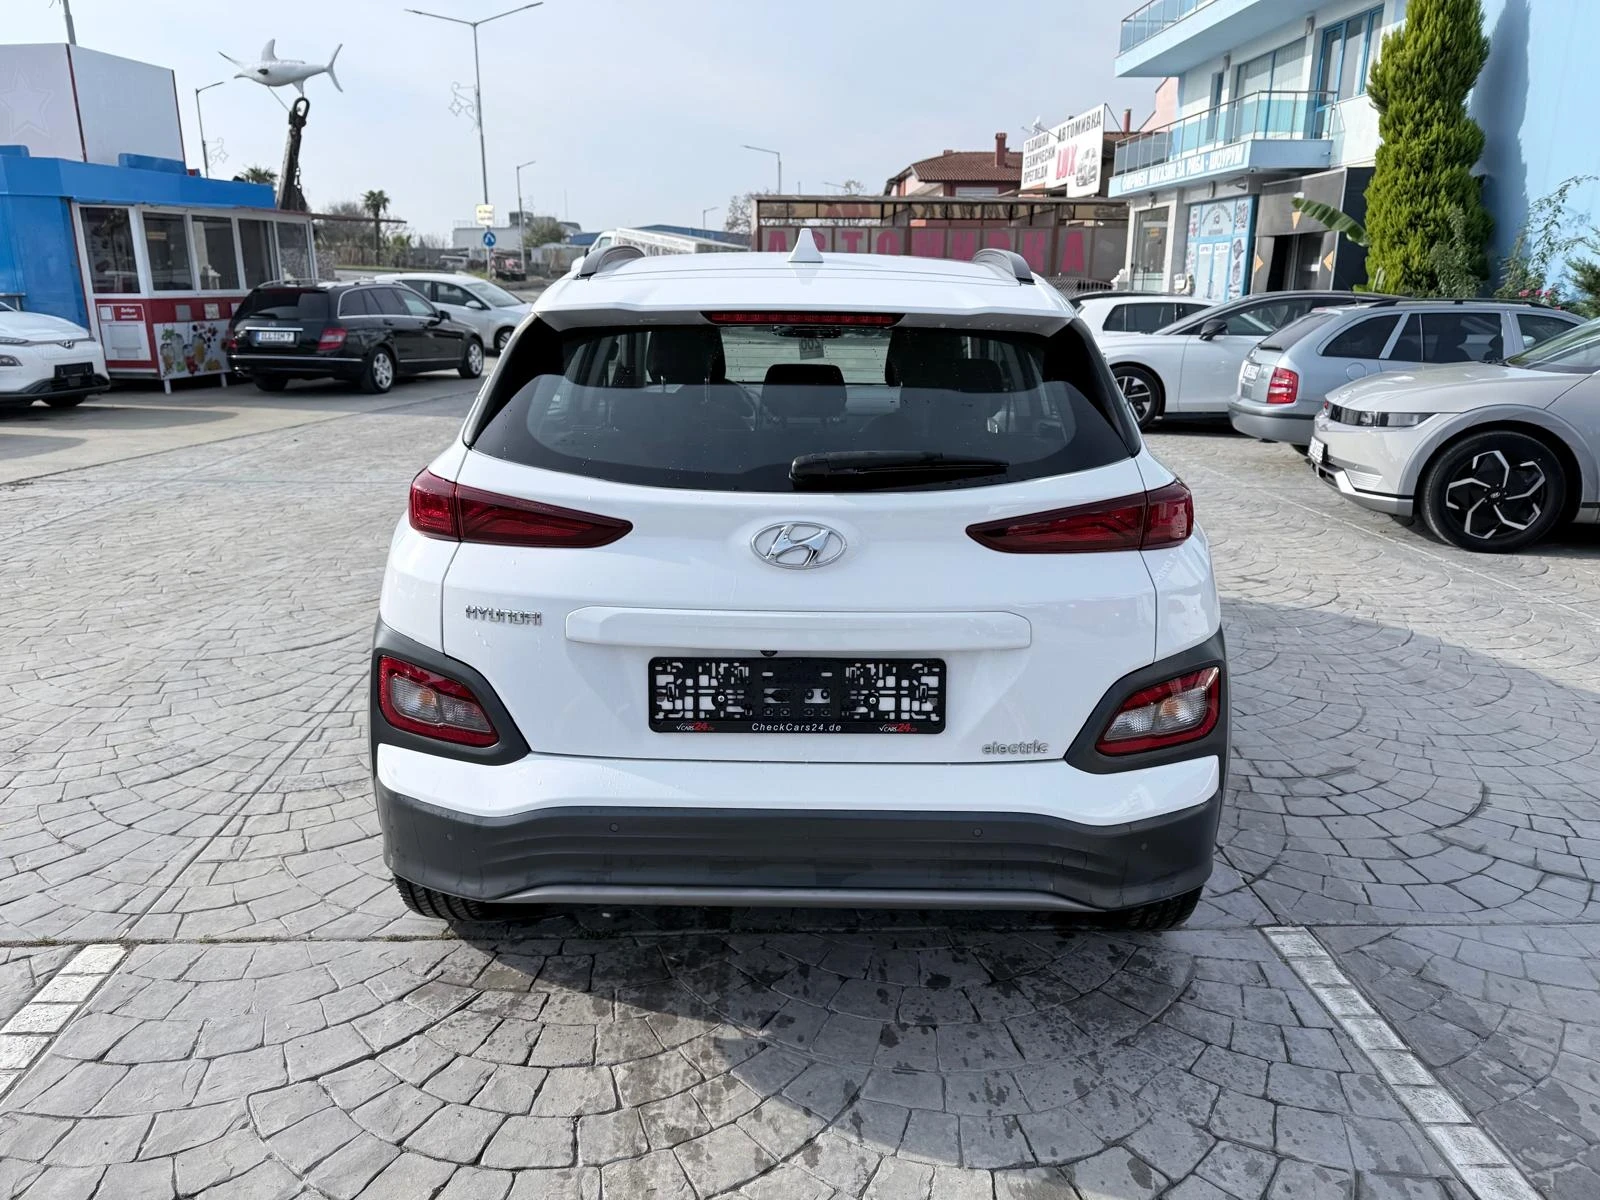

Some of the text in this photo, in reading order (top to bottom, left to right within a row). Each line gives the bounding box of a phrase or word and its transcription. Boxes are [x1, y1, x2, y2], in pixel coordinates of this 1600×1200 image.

[1058, 110, 1101, 143] АВТОМИВКА
[1056, 144, 1078, 180] LUX
[465, 605, 542, 626] HYUNDAI
[751, 723, 842, 732] CheckCars24.de
[982, 739, 1049, 755] electric
